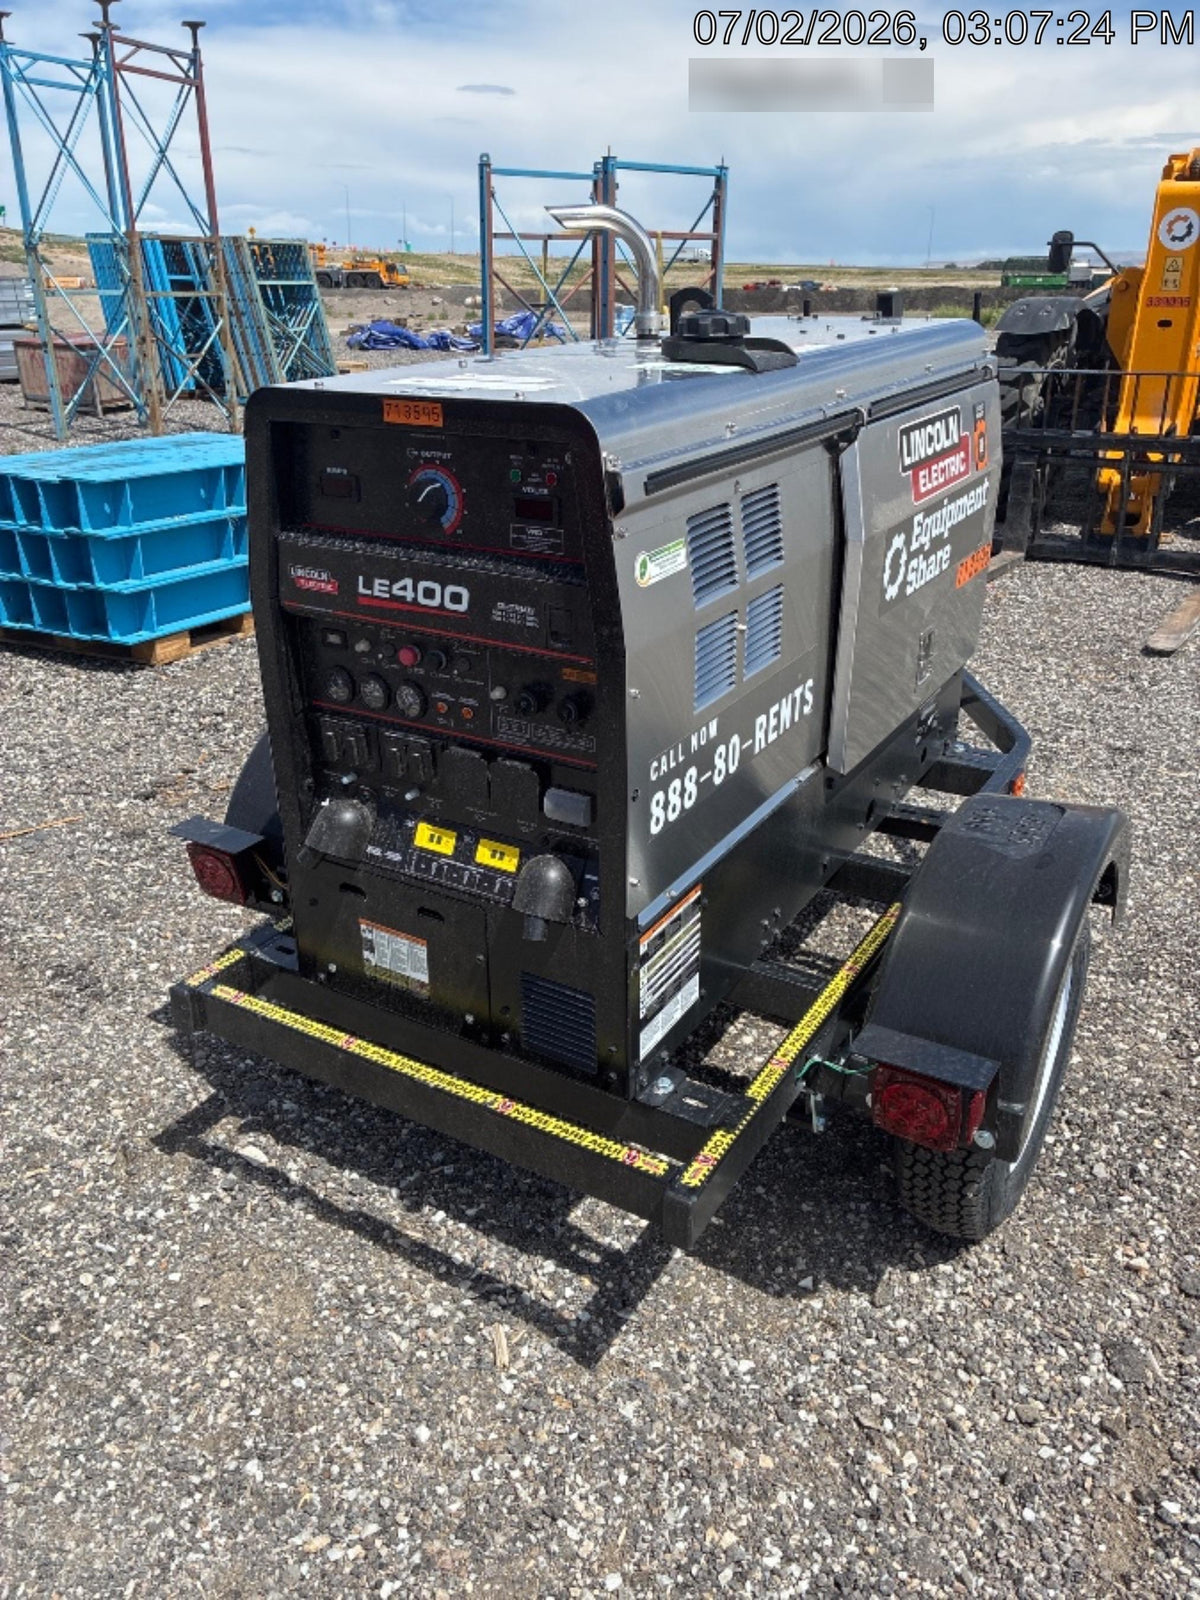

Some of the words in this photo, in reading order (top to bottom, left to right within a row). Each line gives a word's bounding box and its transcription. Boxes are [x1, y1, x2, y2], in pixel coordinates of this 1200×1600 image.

[385, 402, 440, 423] 713595
[902, 413, 960, 467] LINCOLN
[918, 450, 967, 494] ELECTRIC
[911, 477, 990, 553] Equipment
[358, 575, 470, 613] LE400
[906, 544, 952, 596] Share
[650, 743, 685, 782] CALL
[691, 717, 719, 753] NOW
[650, 678, 814, 835] 888-80-RENTS
[512, 1105, 534, 1121] NO
